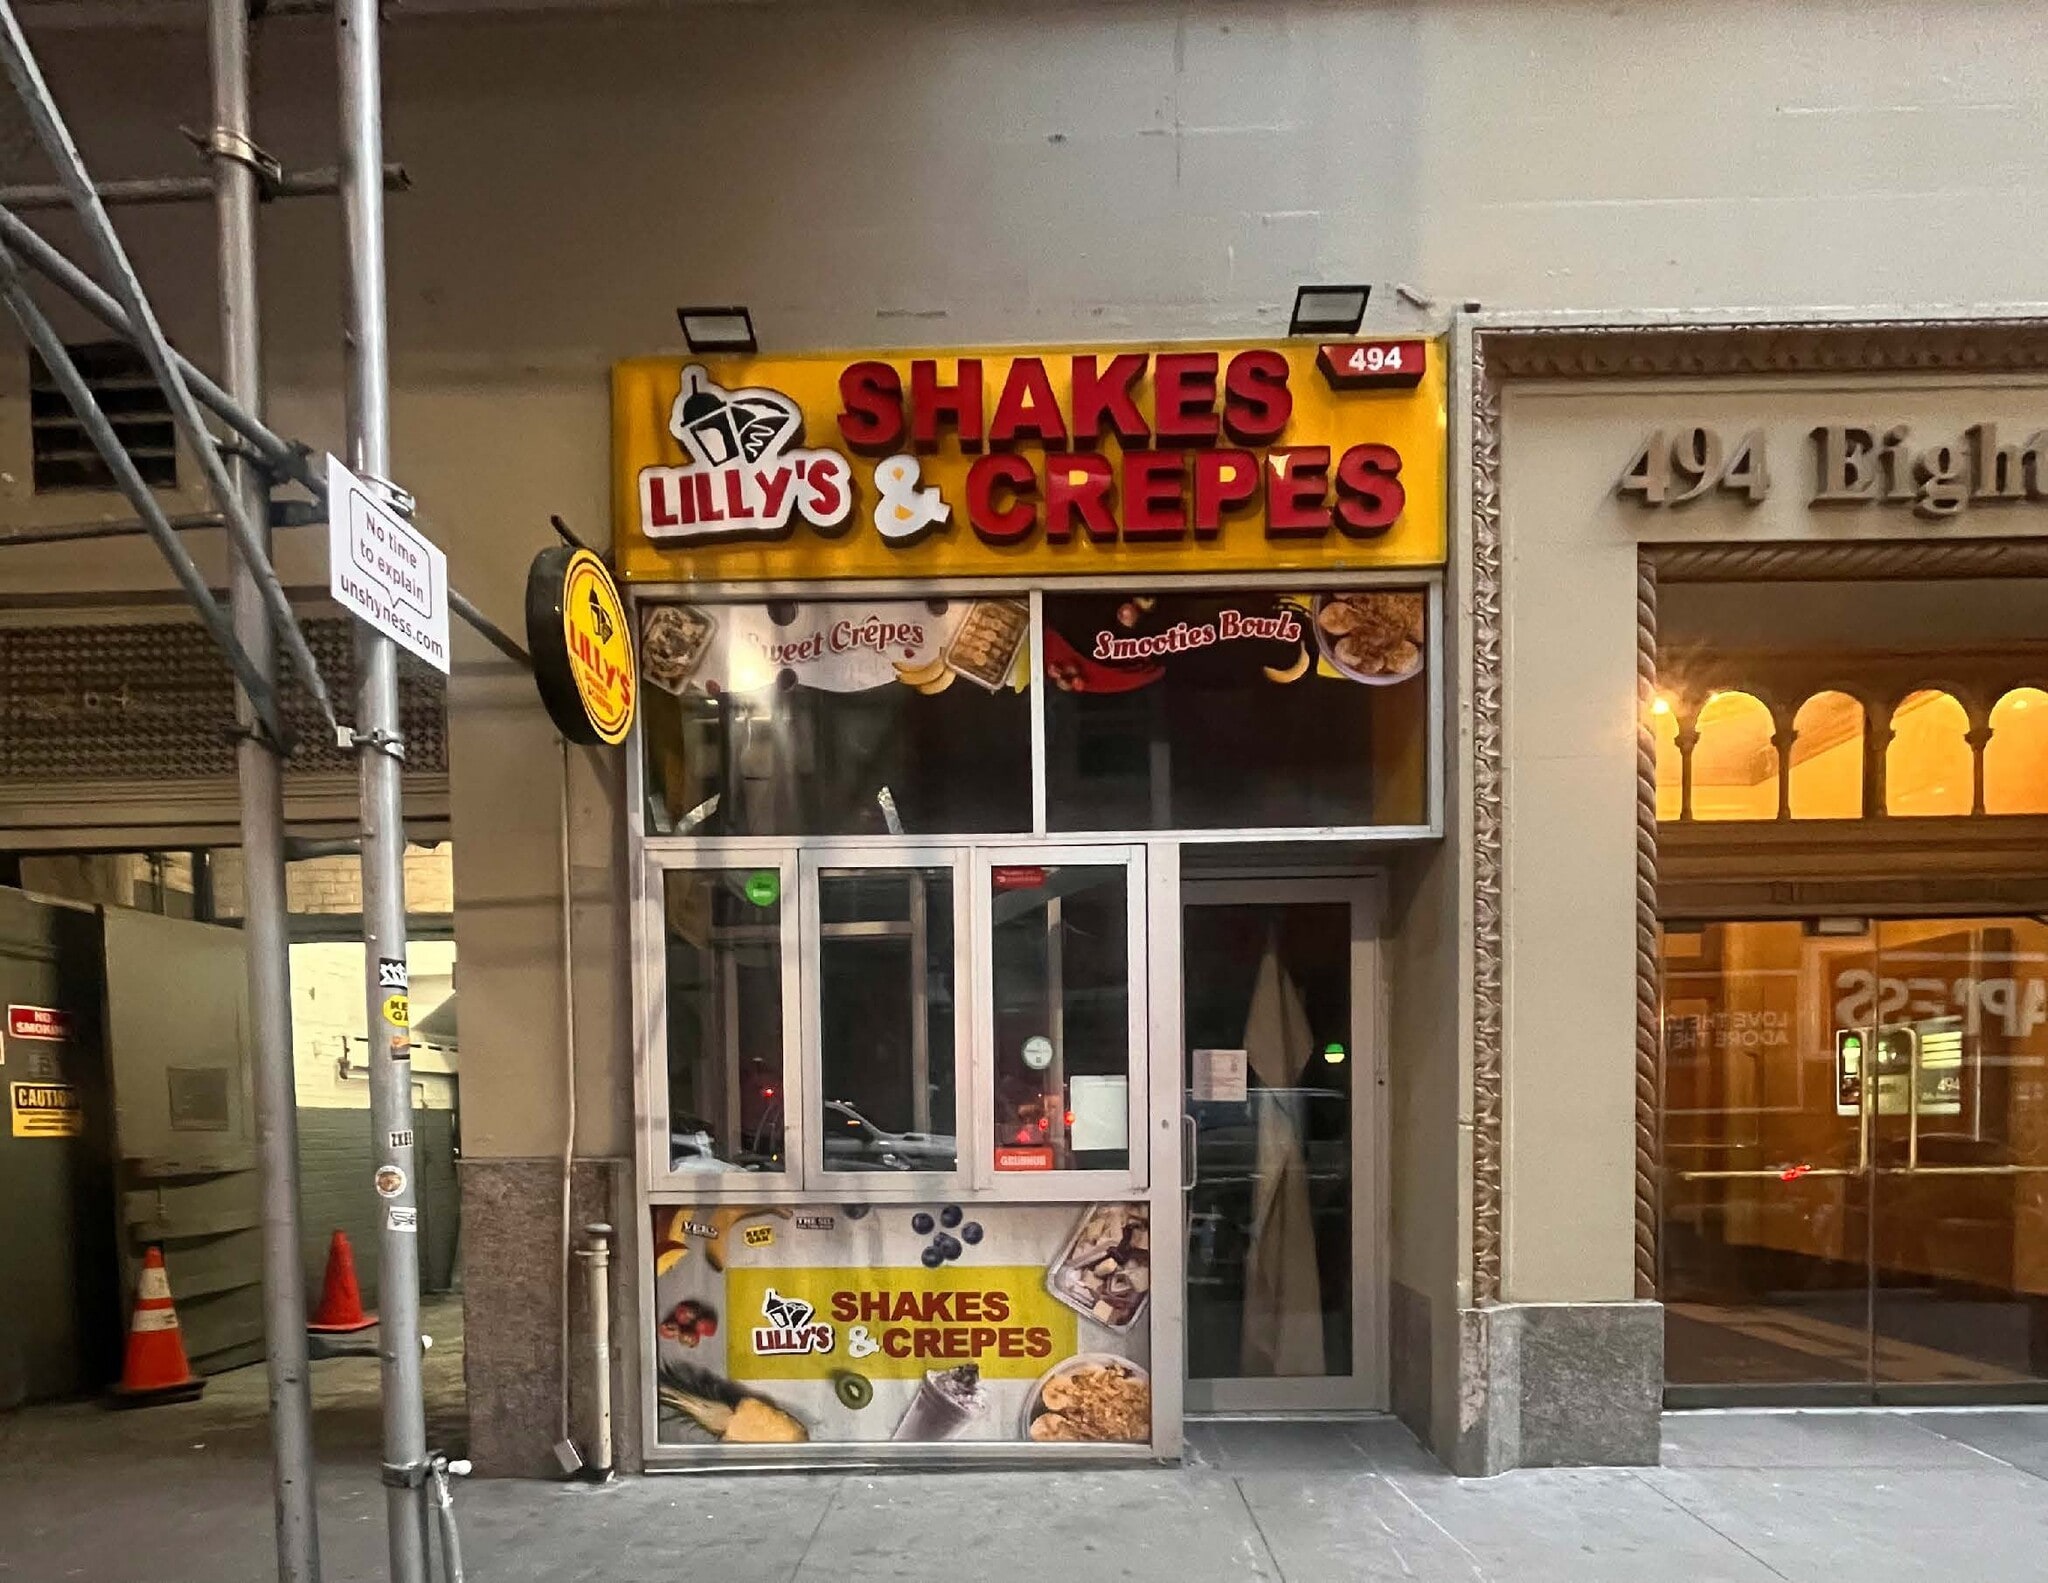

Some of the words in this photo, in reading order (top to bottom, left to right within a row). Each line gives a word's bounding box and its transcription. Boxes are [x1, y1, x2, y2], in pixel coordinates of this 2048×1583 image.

[1348, 346, 1403, 371] 494
[838, 349, 1292, 454] SHAKES
[1605, 425, 1769, 508] 494
[649, 458, 841, 527] LILLY'S
[873, 453, 951, 538] &
[965, 443, 1405, 545] CREPES
[366, 511, 385, 543] No
[388, 531, 417, 569] time
[360, 537, 374, 563] to
[377, 558, 424, 604] explain
[340, 573, 443, 658] unshyness.com
[750, 631, 823, 664] weet
[830, 615, 925, 652] Crêpes
[1094, 622, 1214, 660] Smooties
[1218, 609, 1301, 643] Bowls
[16, 1021, 74, 1037] SMOKIN
[18, 1087, 79, 1108] CAUTIO
[831, 1291, 1010, 1322] SHAKES
[755, 1326, 831, 1350] LILLY'S
[848, 1326, 880, 1359] &
[882, 1327, 1053, 1358] CREPES
